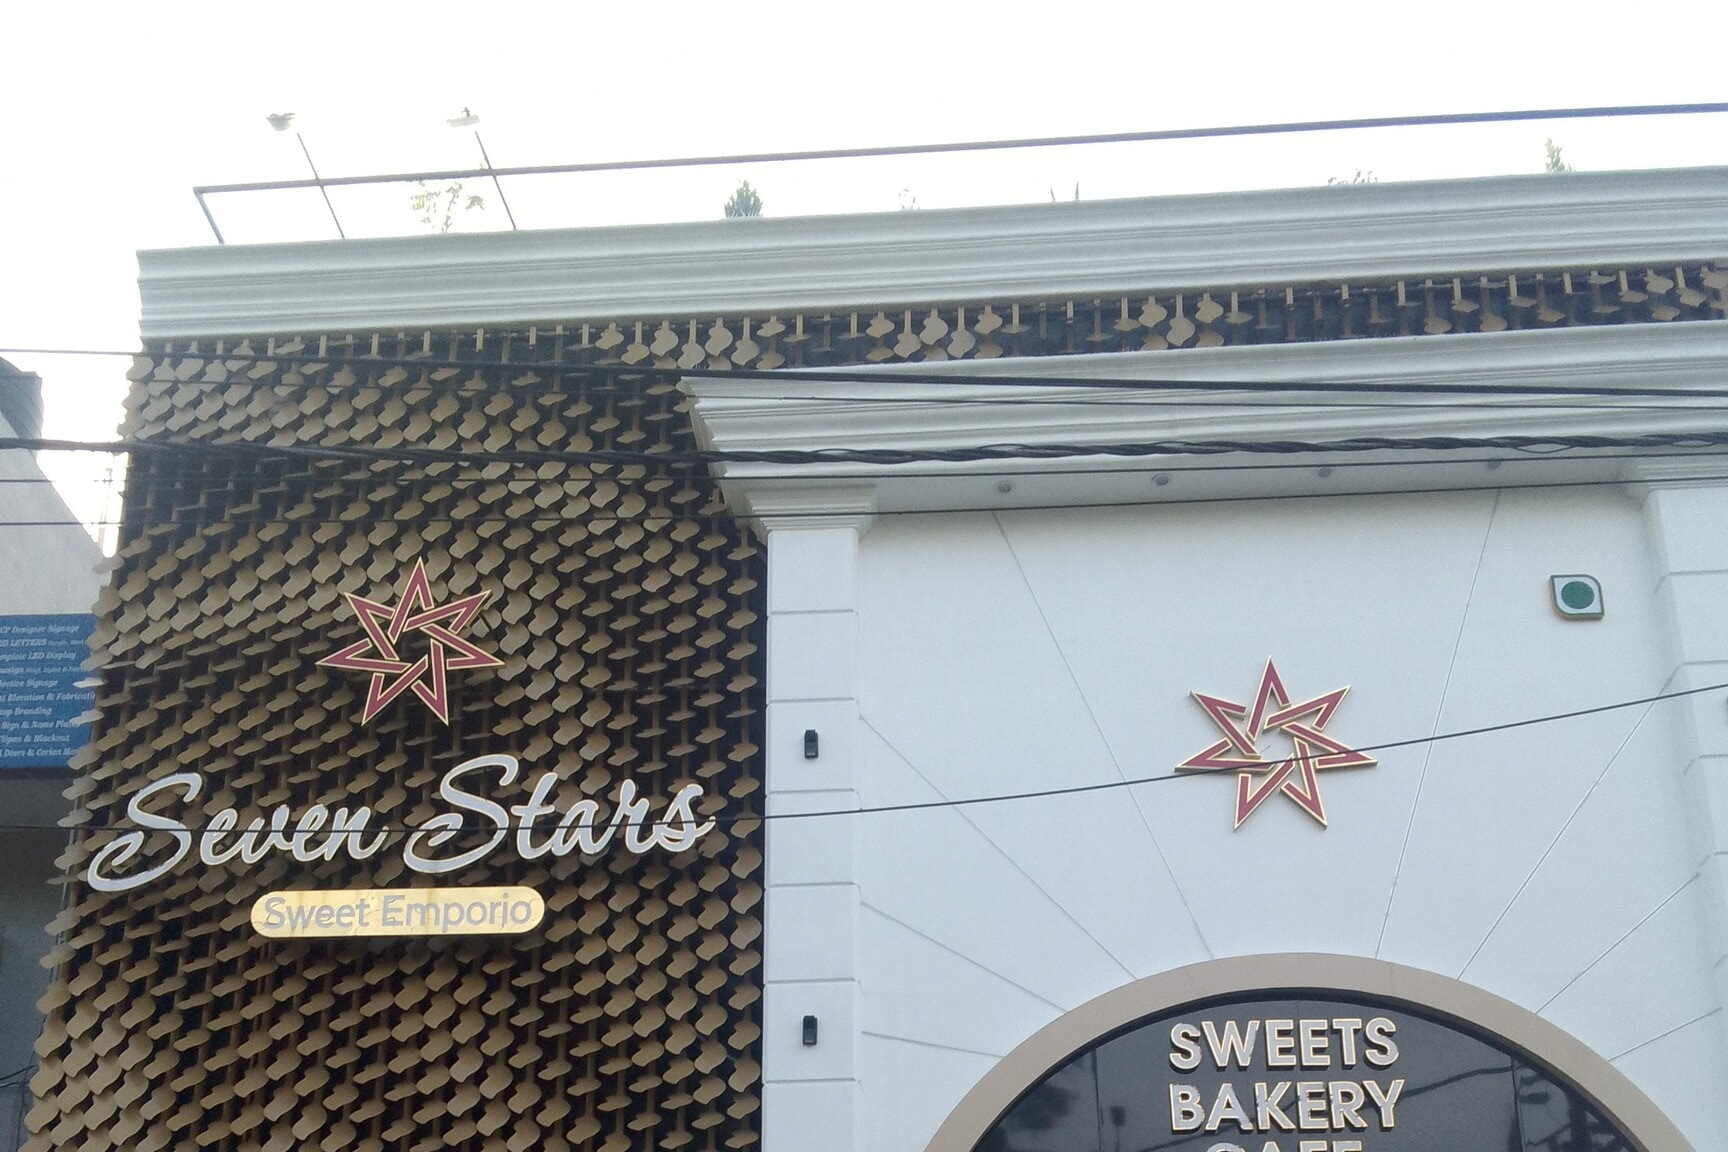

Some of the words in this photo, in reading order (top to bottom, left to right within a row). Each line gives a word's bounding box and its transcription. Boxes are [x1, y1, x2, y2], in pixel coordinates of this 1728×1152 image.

[10, 638, 47, 647] LETTERS
[28, 651, 45, 660] LED
[87, 771, 389, 892] Seven
[403, 753, 715, 875] Stars
[264, 896, 370, 930] Sweet
[381, 892, 532, 933] Emporio
[1168, 1017, 1400, 1071] SWEETS
[1169, 1079, 1406, 1132] BAKERY
